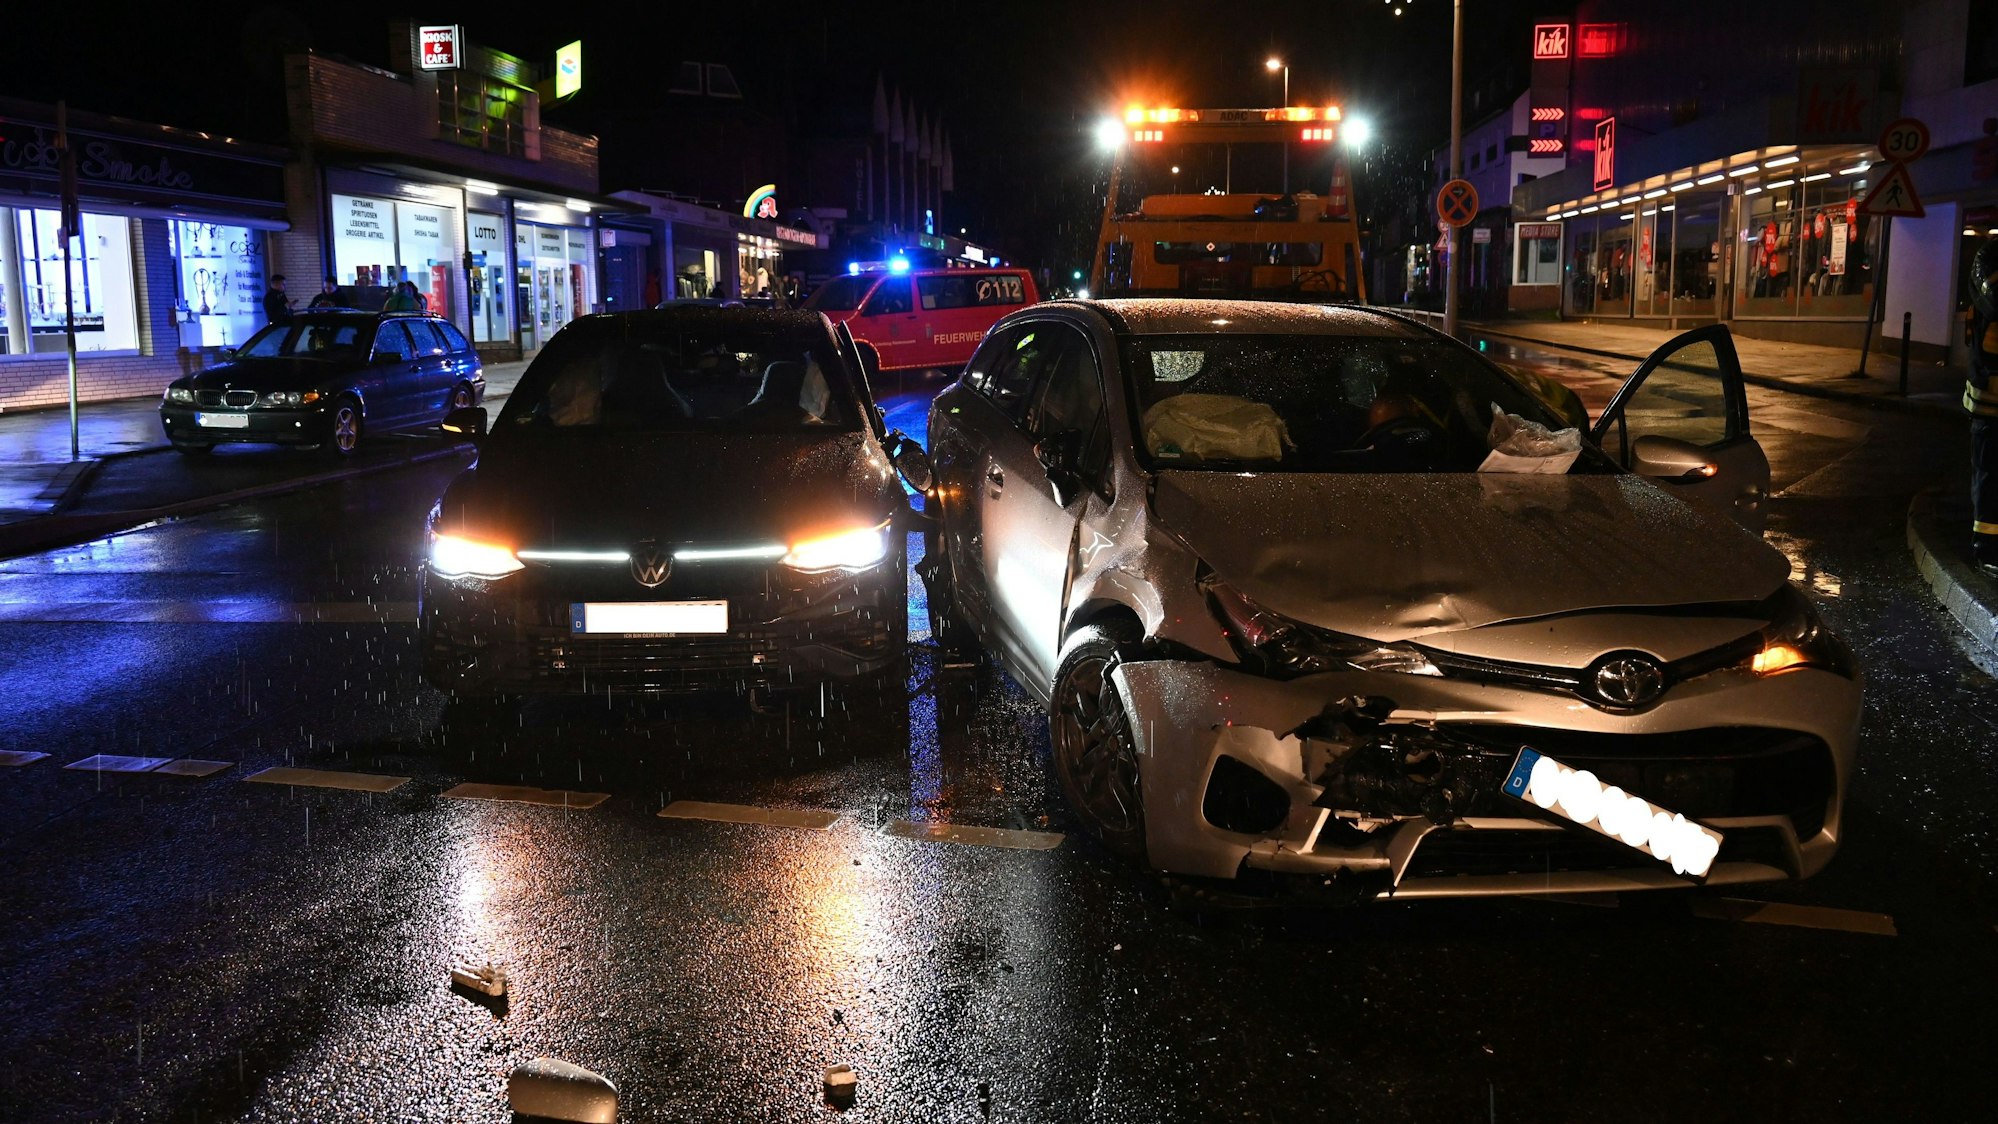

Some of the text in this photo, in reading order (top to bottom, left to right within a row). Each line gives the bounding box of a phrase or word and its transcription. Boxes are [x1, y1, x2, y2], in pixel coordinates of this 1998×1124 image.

[423, 32, 453, 43] KIOSK
[1537, 30, 1566, 55] kik
[433, 43, 443, 53] &
[1220, 111, 1248, 121] ADAC
[1889, 131, 1920, 151] 30
[1596, 130, 1613, 184] kik
[81, 141, 194, 189] Smoke
[352, 199, 374, 209] GETRÄNKE
[350, 209, 378, 219] SPIRITUOSEN
[350, 219, 380, 230] LEBENSMITTEL
[345, 229, 385, 240] DROGERIE ARTIKEL
[474, 226, 497, 240] LOTTO
[1520, 225, 1560, 237] MEDIA STORE
[993, 281, 1021, 298] 112
[934, 331, 987, 345] FEUERWEH
[575, 620, 582, 629] D
[1512, 776, 1523, 788] D
